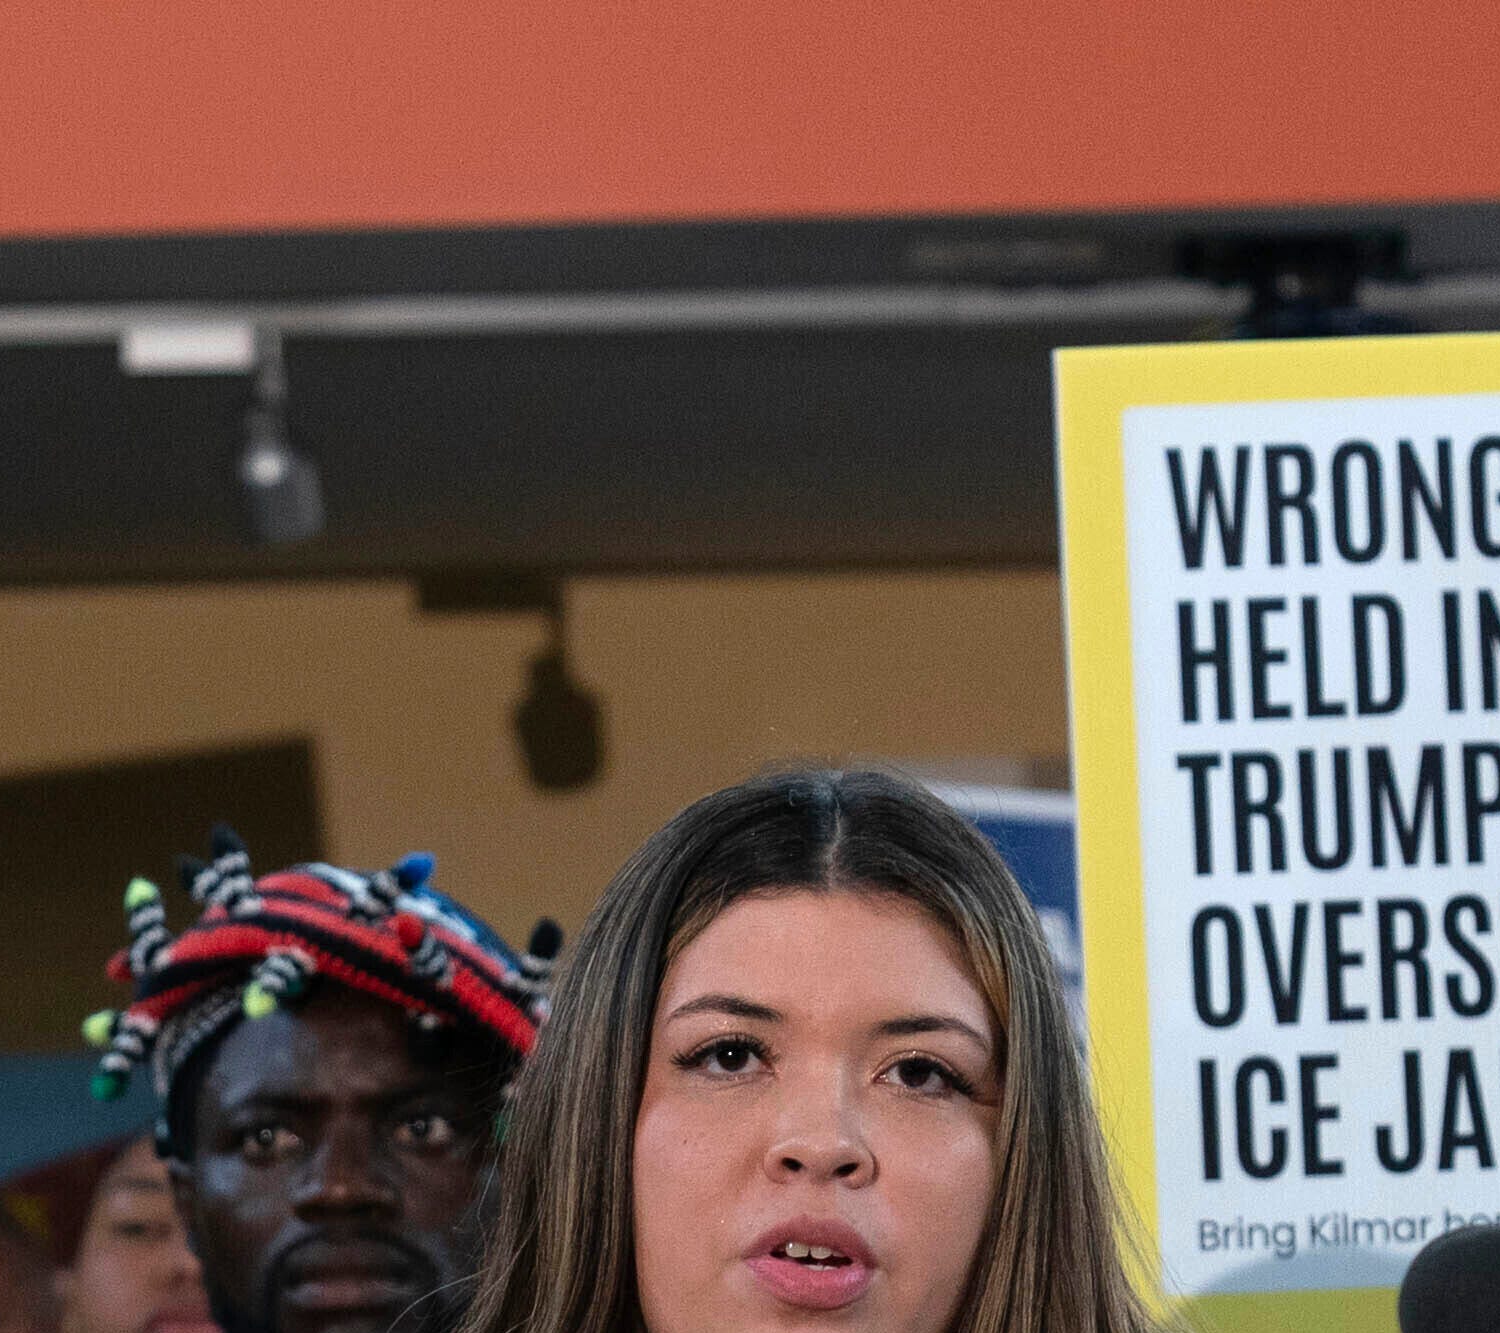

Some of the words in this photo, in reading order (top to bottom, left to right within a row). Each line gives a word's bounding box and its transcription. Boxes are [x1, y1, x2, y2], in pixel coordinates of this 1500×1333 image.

[1177, 594, 1406, 724] HELD
[1198, 1054, 1344, 1182] ICE
[1198, 1215, 1298, 1259] Bring
[1309, 1212, 1432, 1248] Kilmar
